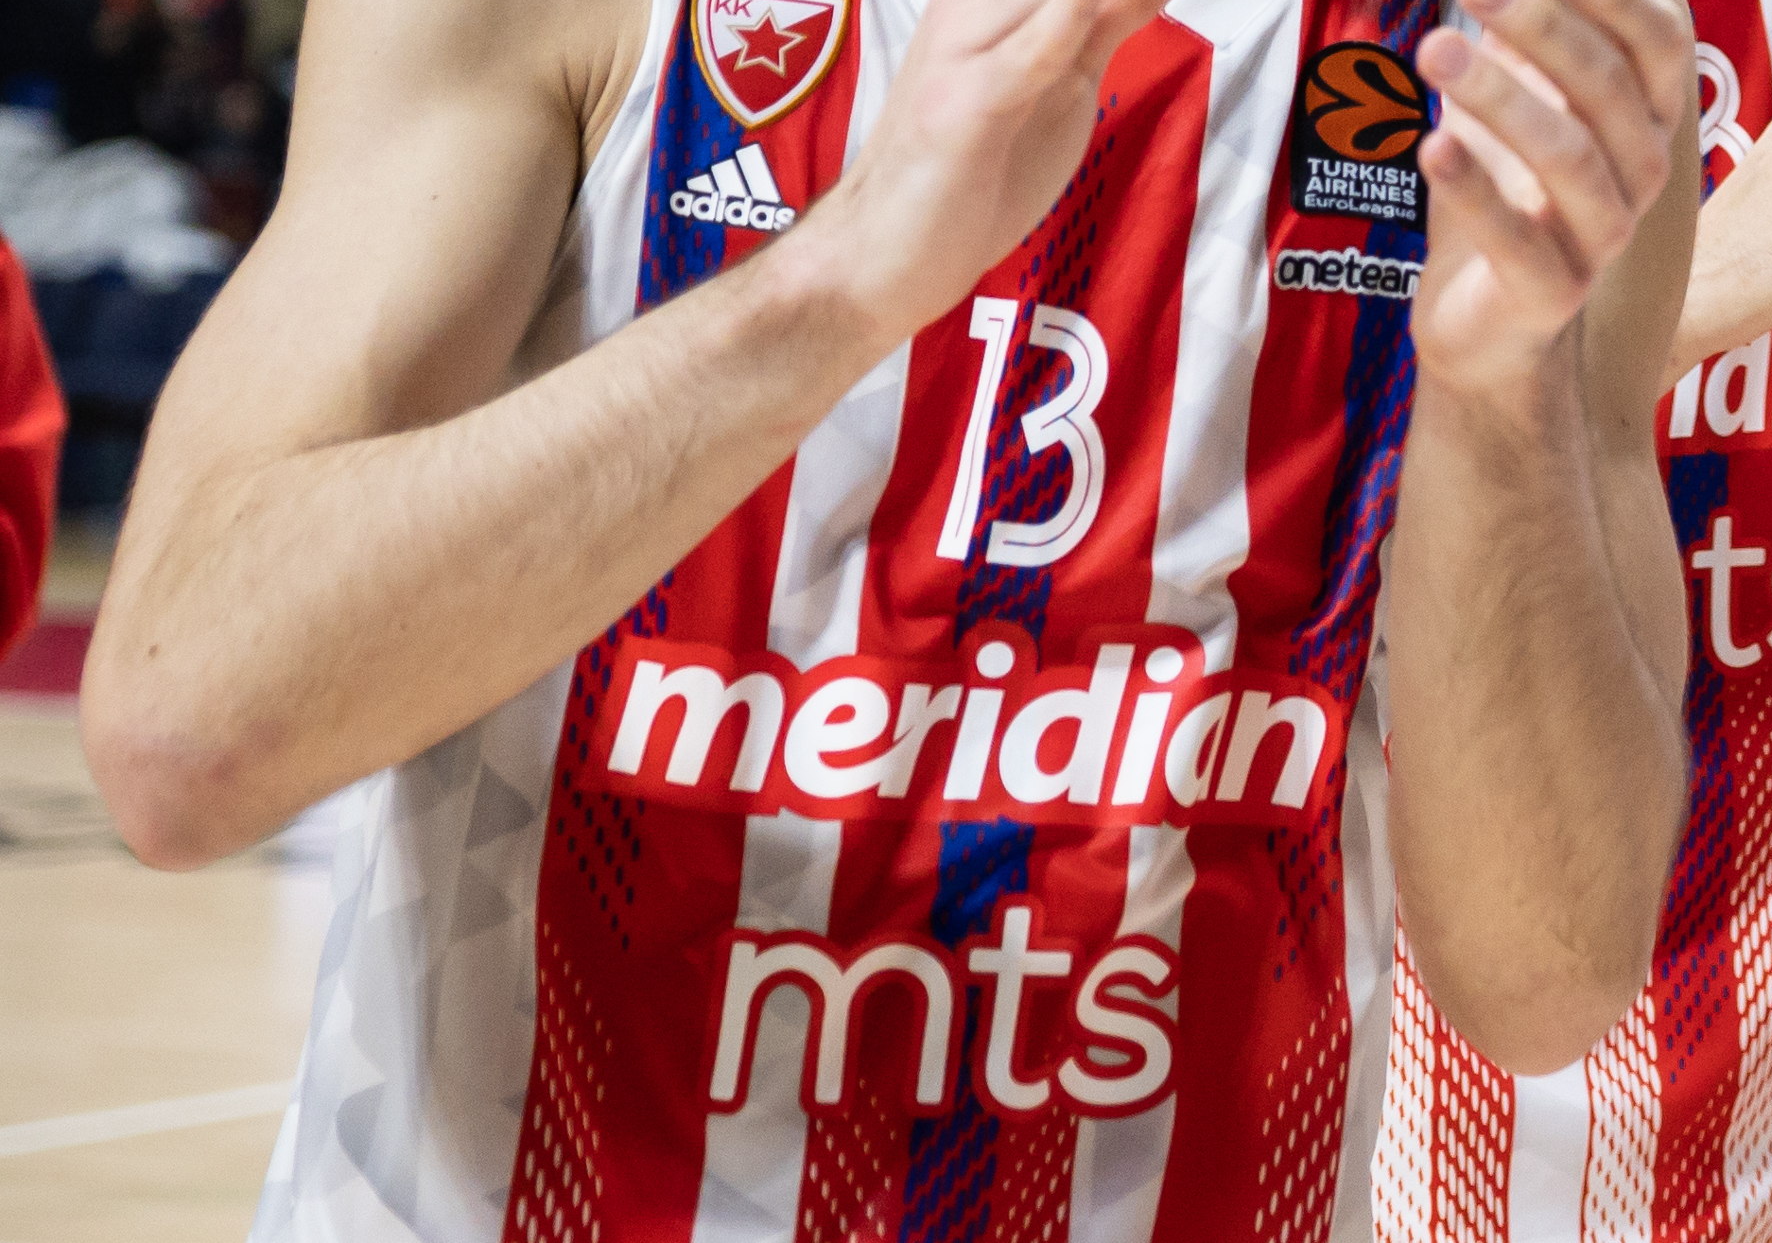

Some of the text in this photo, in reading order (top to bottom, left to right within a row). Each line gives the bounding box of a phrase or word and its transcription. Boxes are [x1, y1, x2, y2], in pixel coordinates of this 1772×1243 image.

[1306, 175, 1416, 206] AIRLINES
[1307, 157, 1417, 189] TURKISH
[669, 190, 796, 231] adidas
[1304, 193, 1417, 221] EuroLeague
[936, 296, 1108, 567] 13
[607, 641, 1327, 809] meridian
[709, 906, 1173, 1111] mts
